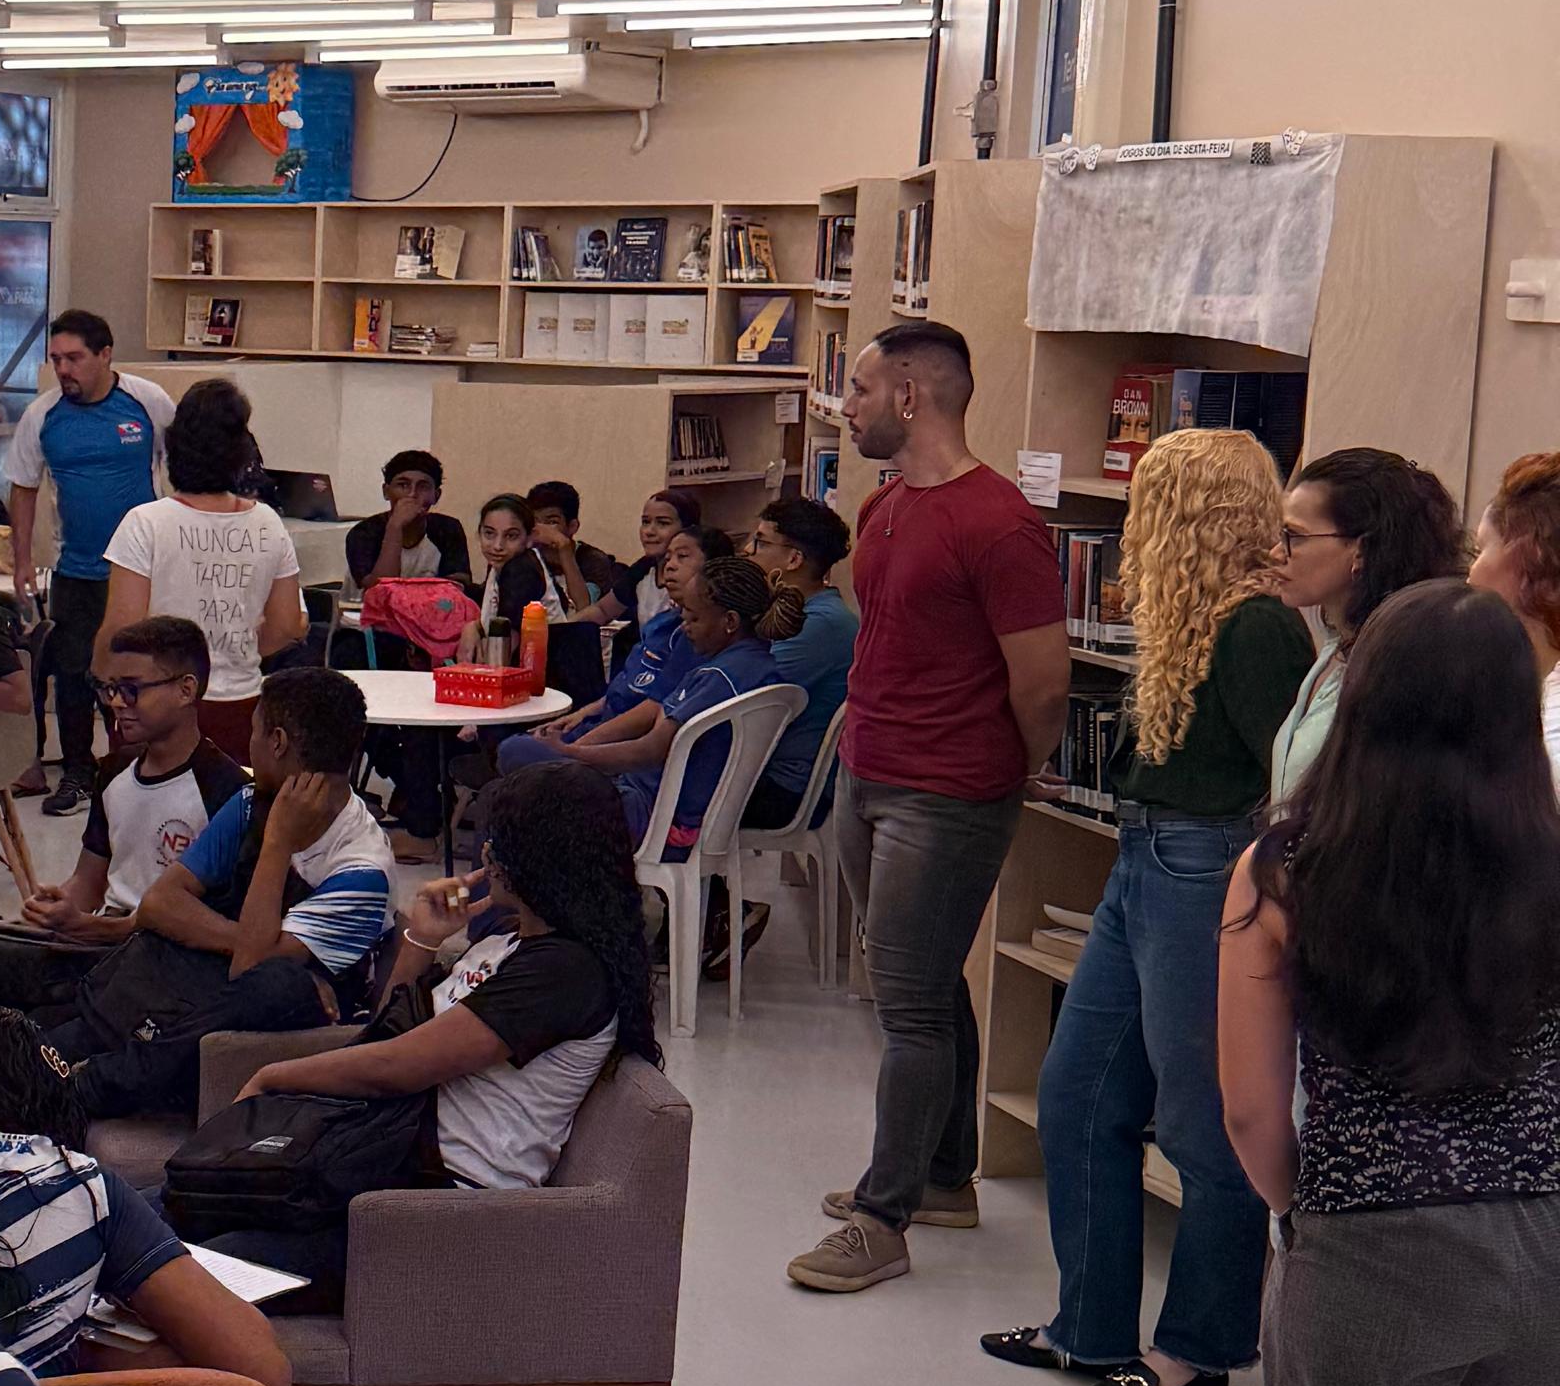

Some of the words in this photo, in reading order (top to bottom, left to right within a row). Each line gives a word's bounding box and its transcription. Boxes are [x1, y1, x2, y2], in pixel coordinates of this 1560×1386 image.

[1157, 144, 1171, 156] DIA
[1173, 144, 1183, 155] DE
[1184, 142, 1231, 155] SEXTA-FEIRA
[1123, 388, 1142, 400] DAN
[1112, 399, 1149, 416] BROWN
[179, 524, 254, 554] NUNCA
[194, 561, 253, 589] TARDE
